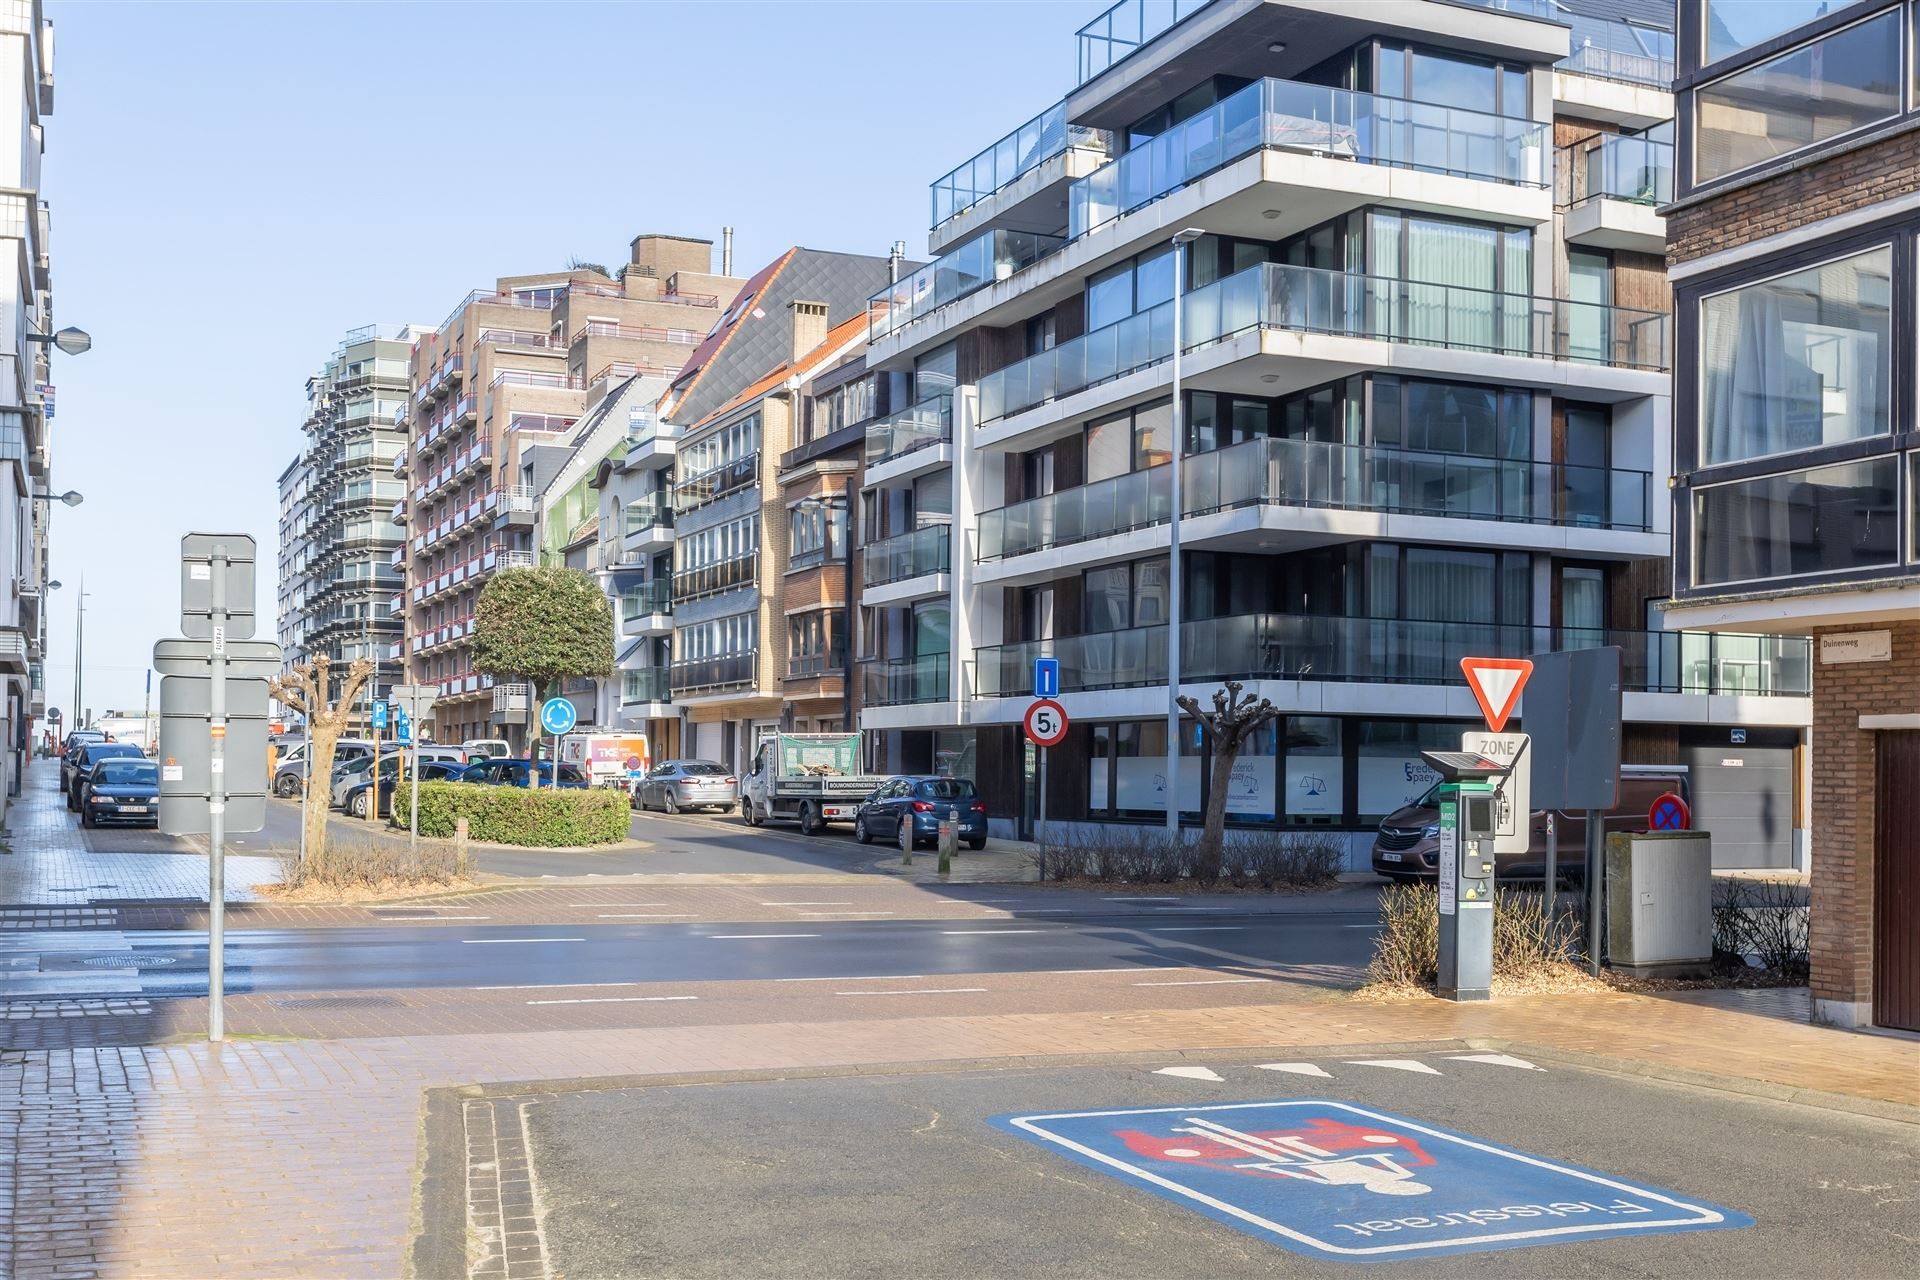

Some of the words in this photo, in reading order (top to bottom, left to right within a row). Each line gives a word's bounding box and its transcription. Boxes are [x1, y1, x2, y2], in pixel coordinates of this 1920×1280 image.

[1824, 639, 1858, 648] Duinenweg
[375, 704, 384, 717] P
[1480, 740, 1514, 755] ZONE
[1406, 772, 1435, 784] Spaey
[1334, 1199, 1654, 1237] Fietsstraat
